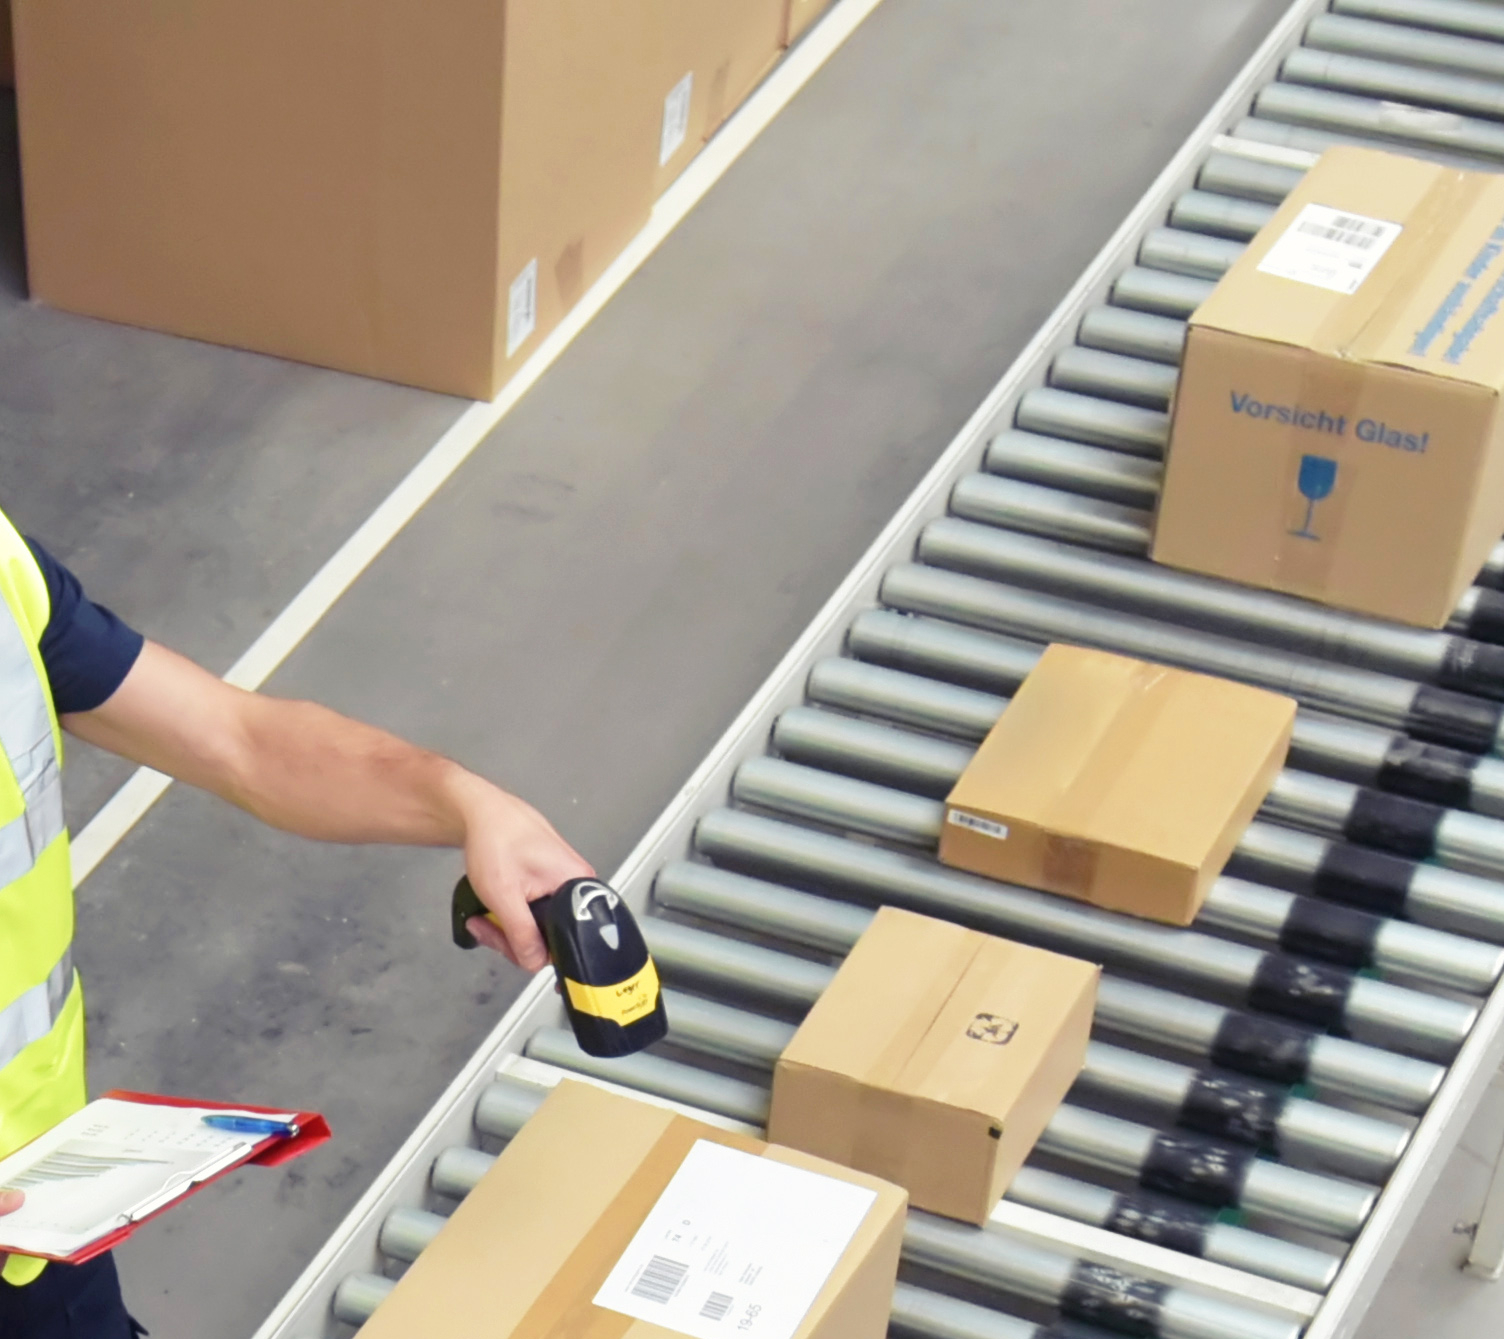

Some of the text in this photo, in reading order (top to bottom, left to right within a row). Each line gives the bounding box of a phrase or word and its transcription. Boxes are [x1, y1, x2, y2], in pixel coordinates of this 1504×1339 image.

[1230, 389, 1430, 454] Vorsicht Glas!
[737, 1303, 763, 1331] 19-65
